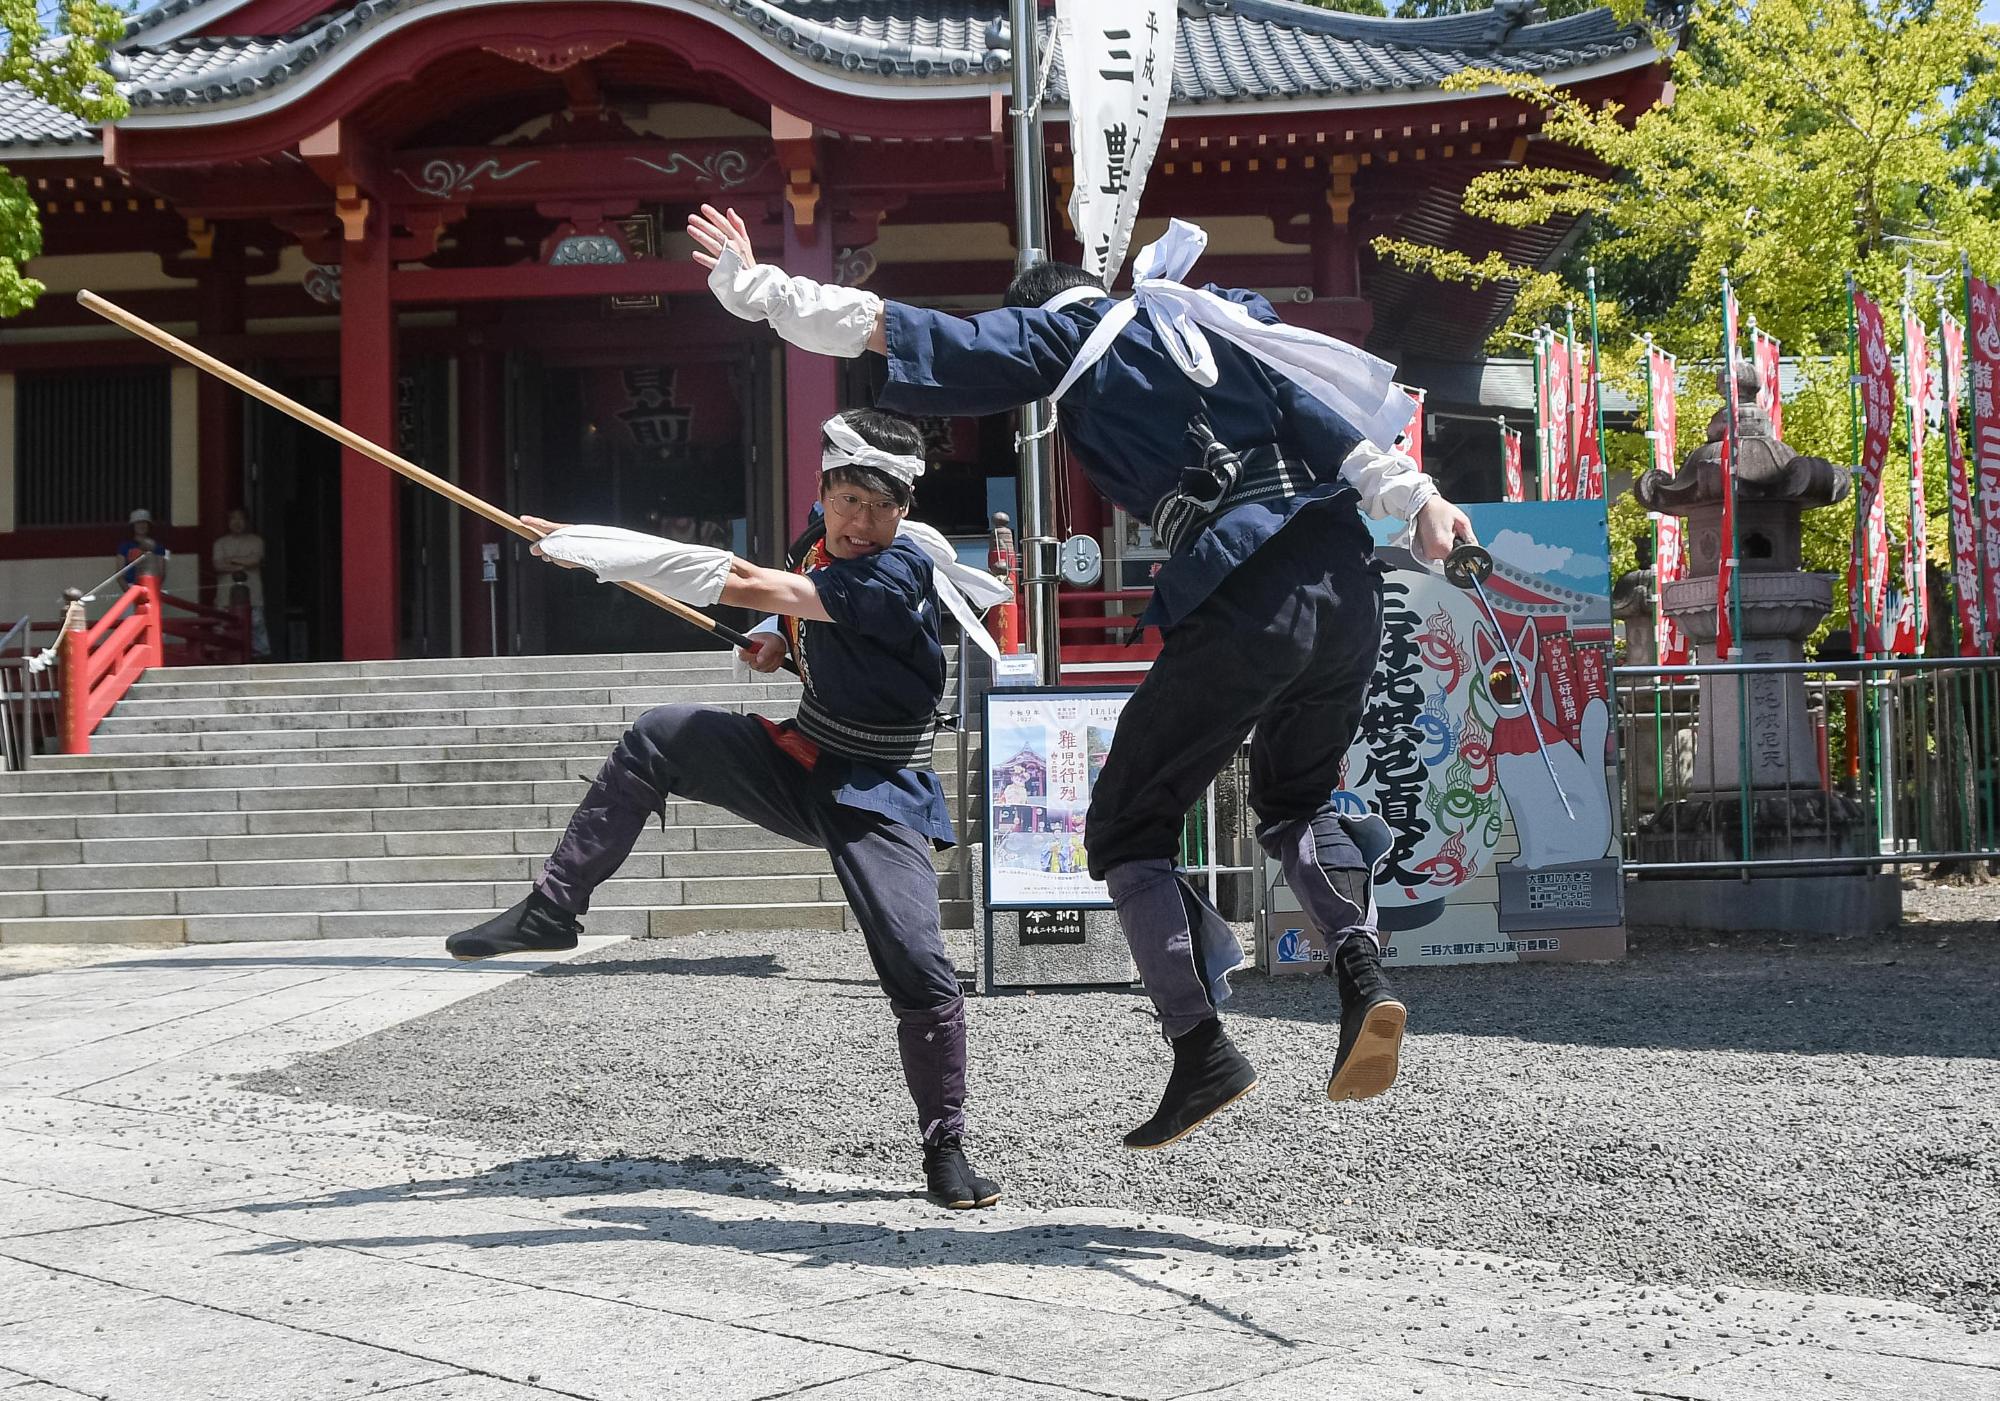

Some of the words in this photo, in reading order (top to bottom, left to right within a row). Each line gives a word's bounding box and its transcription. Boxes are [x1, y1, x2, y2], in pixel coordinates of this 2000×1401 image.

[1557, 672, 1577, 720] 三好稲荷
[1528, 872, 1590, 884] 大提灯の大きさ
